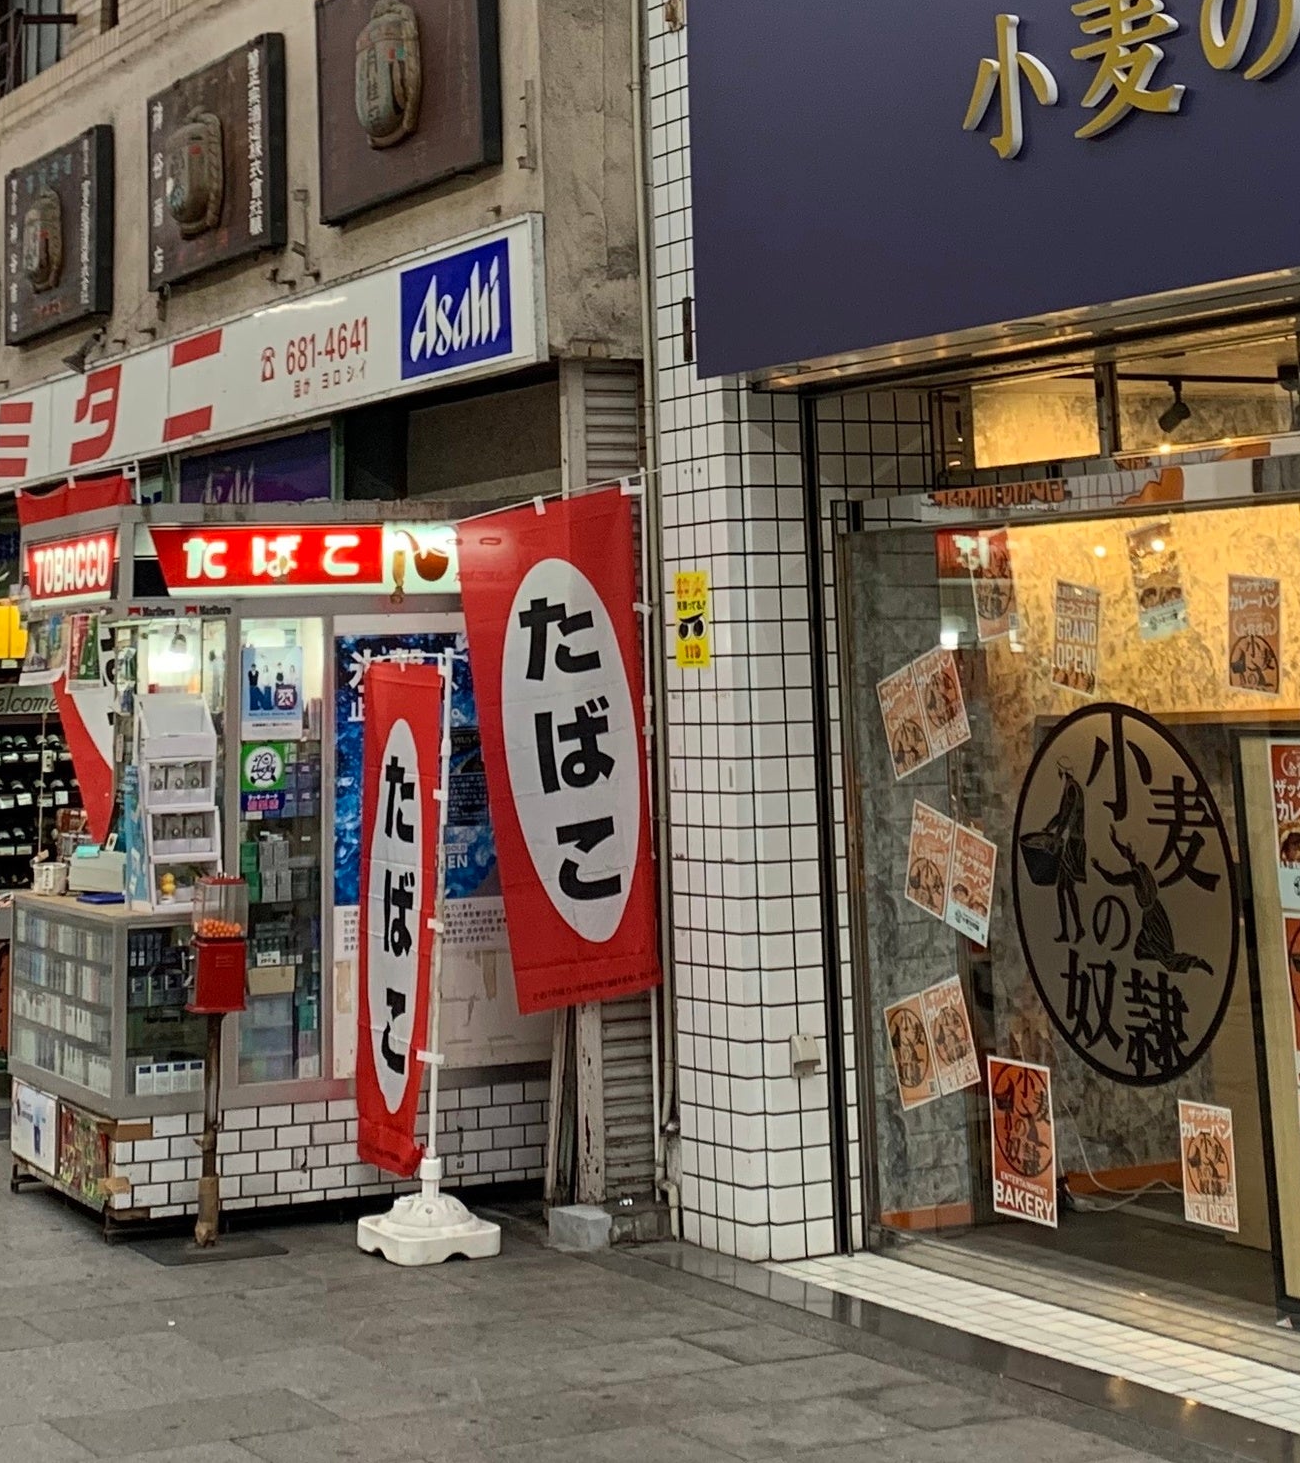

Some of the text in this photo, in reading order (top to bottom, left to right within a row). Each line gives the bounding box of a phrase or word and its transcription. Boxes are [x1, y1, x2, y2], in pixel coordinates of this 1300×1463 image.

[409, 254, 499, 363] Asahi
[286, 315, 369, 376] 681-4641
[33, 540, 109, 596] TOBACCO
[182, 534, 360, 580] たばこ
[1056, 617, 1097, 645] GRAND
[517, 595, 623, 904] たばこ
[382, 754, 416, 1076] たばこ
[1060, 710, 1221, 1077] 小麦の奴隷
[995, 1180, 1055, 1222] BAKERY
